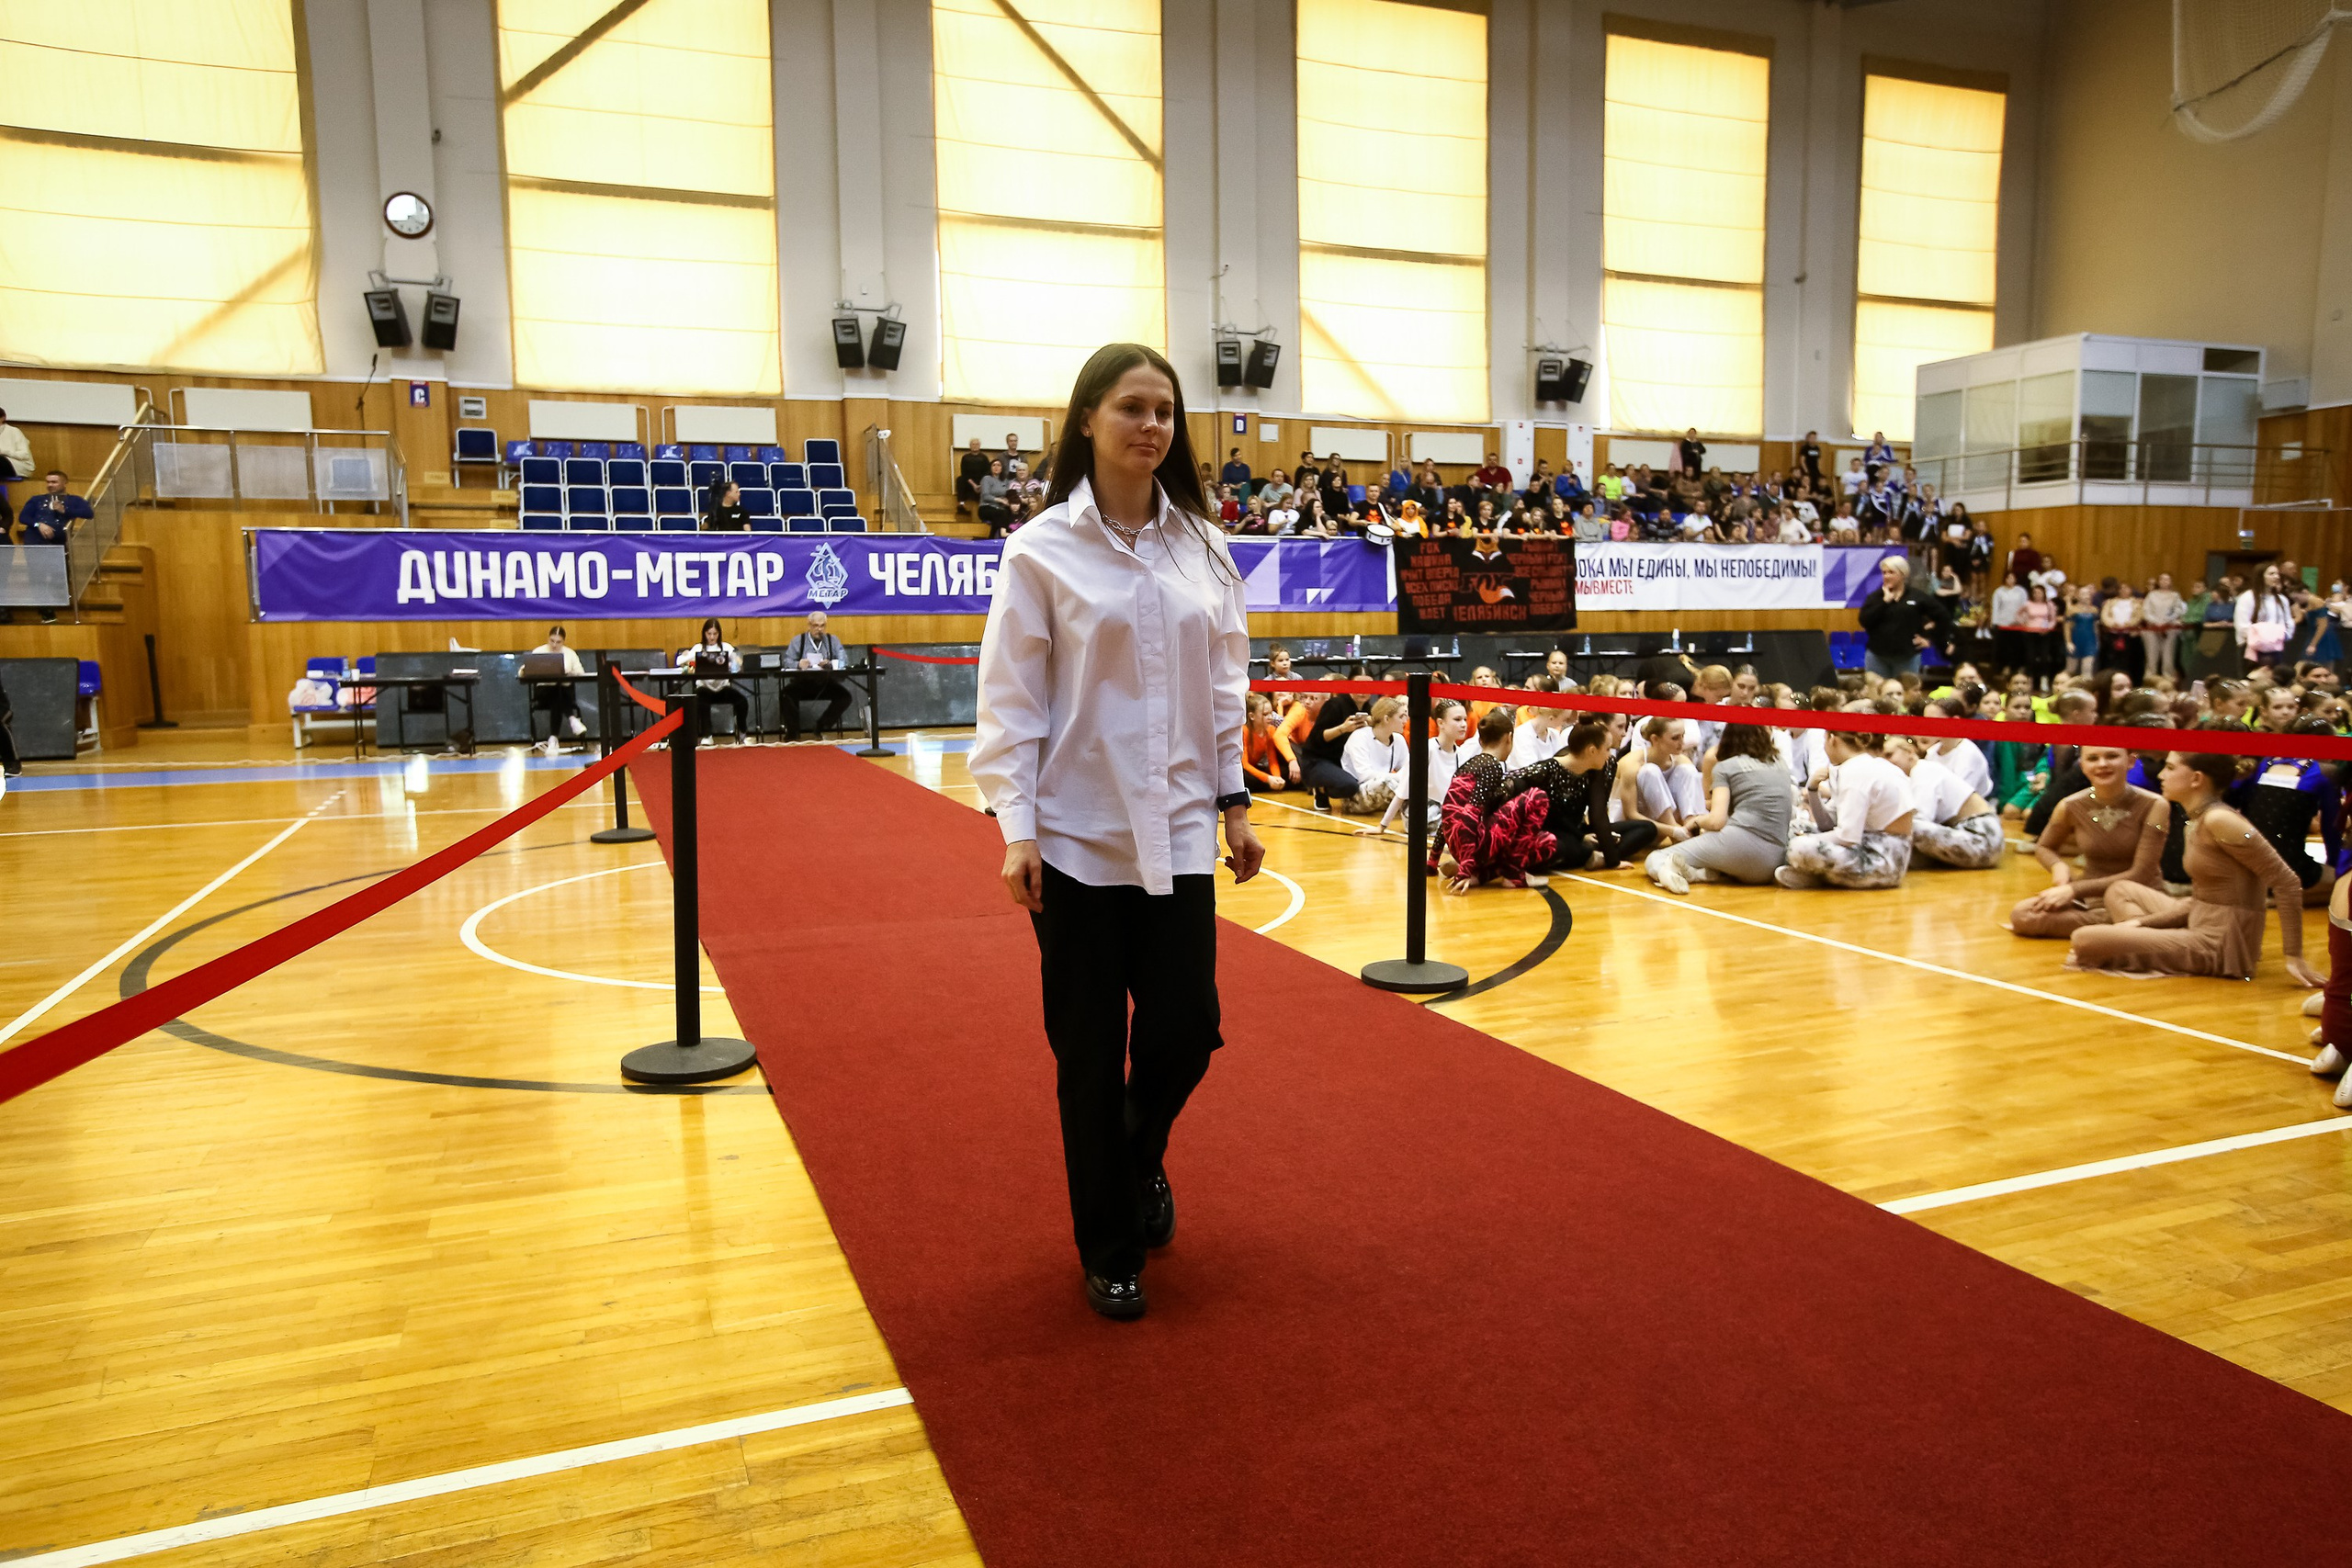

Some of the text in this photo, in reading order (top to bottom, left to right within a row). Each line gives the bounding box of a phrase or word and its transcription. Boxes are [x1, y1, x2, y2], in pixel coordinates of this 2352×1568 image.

[397, 549, 785, 604] ДИНАМО-МЕТАР
[1610, 558, 1633, 578] МЫ
[1638, 558, 1690, 581] ЕДИНЫ,
[1694, 558, 1716, 578] МЫ
[1721, 558, 1817, 581] НЕПОБЕДИМЫ!
